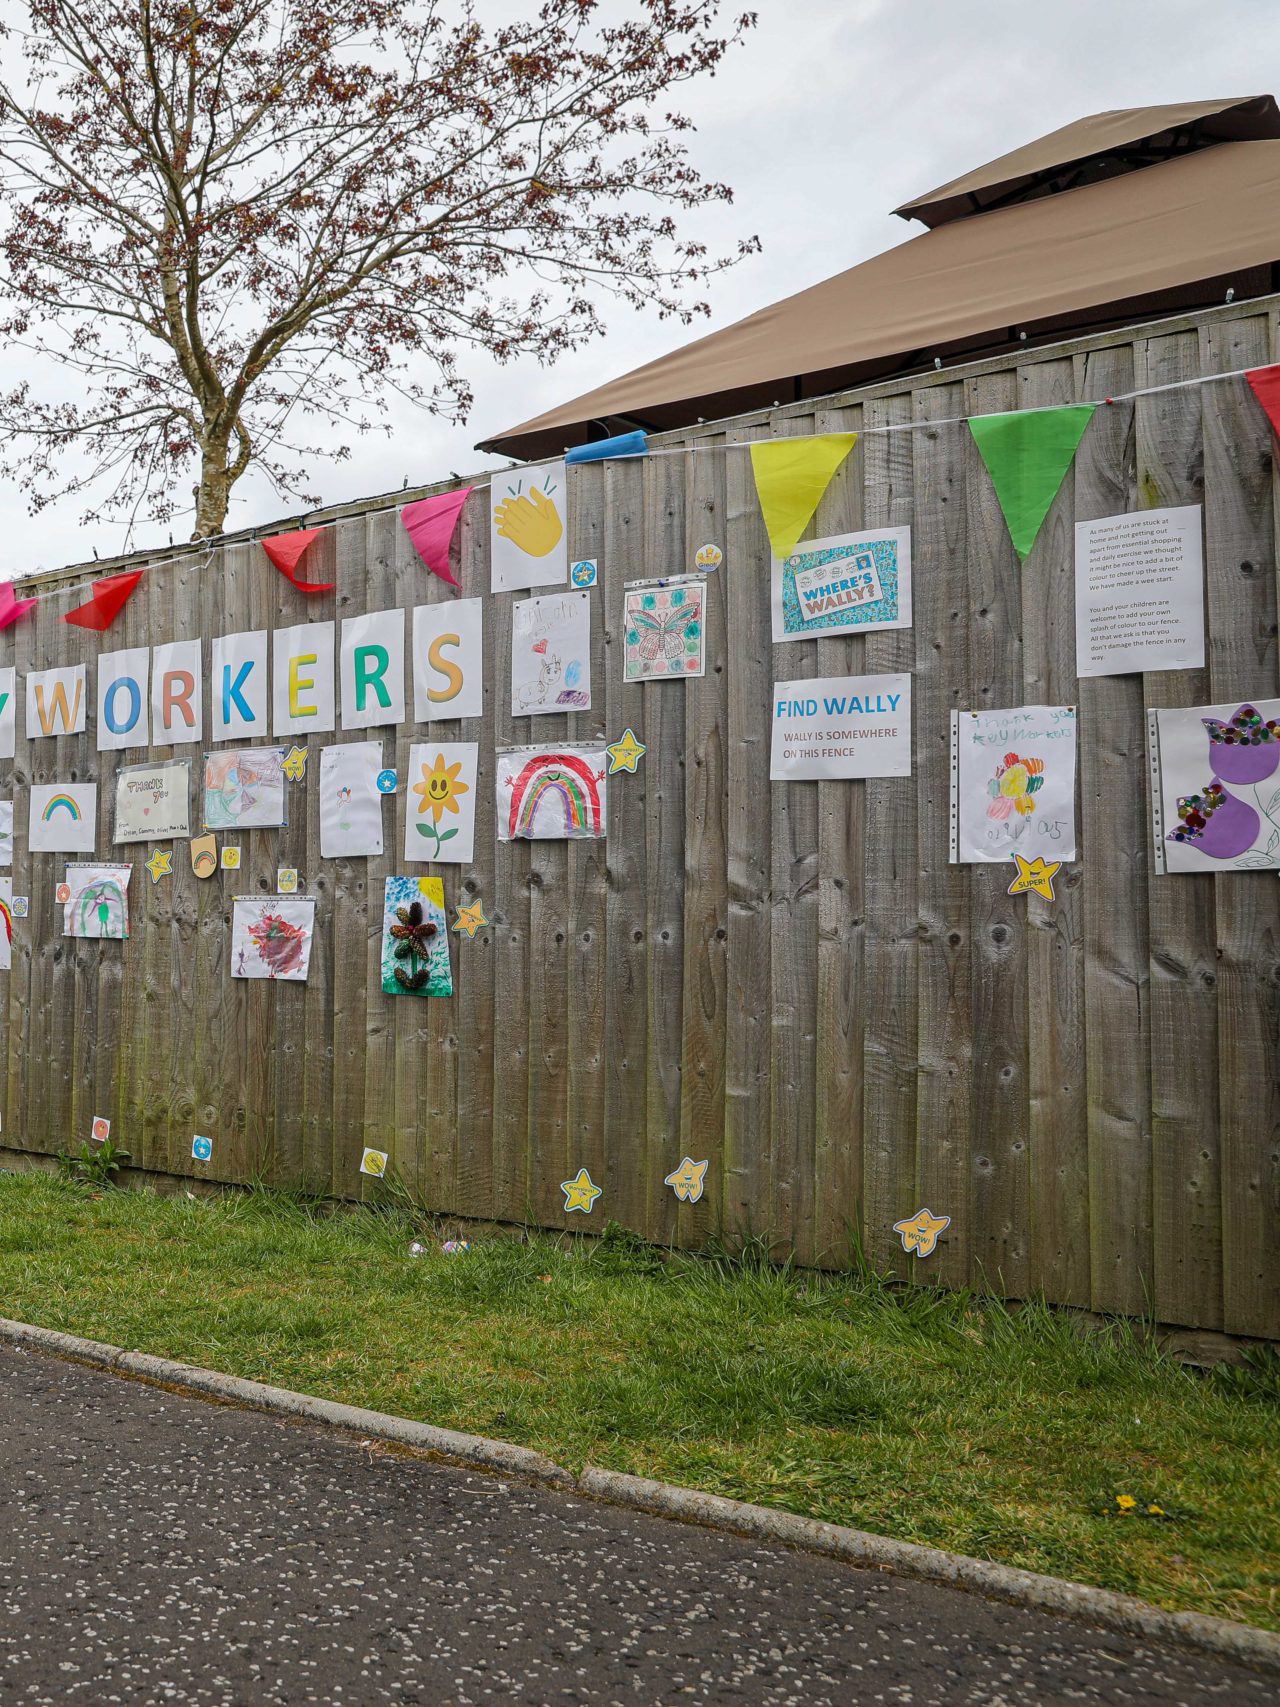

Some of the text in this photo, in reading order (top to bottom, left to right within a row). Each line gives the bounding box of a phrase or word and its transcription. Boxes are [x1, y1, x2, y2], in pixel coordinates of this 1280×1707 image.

[1132, 530, 1154, 538] getting
[1122, 540, 1149, 548] essential
[1117, 551, 1141, 559] exercise
[803, 573, 872, 601] WHERE'S
[805, 584, 874, 614] WALLY?
[1090, 615, 1116, 623] welcome
[34, 633, 464, 735] WORKERS
[777, 694, 901, 718] FIND WALLY
[784, 728, 898, 742] WALLY IS SOMEWHERE
[784, 748, 855, 758] ON THIS FENCE
[1018, 879, 1045, 888] SUPER!
[908, 1231, 931, 1245] WOW!
